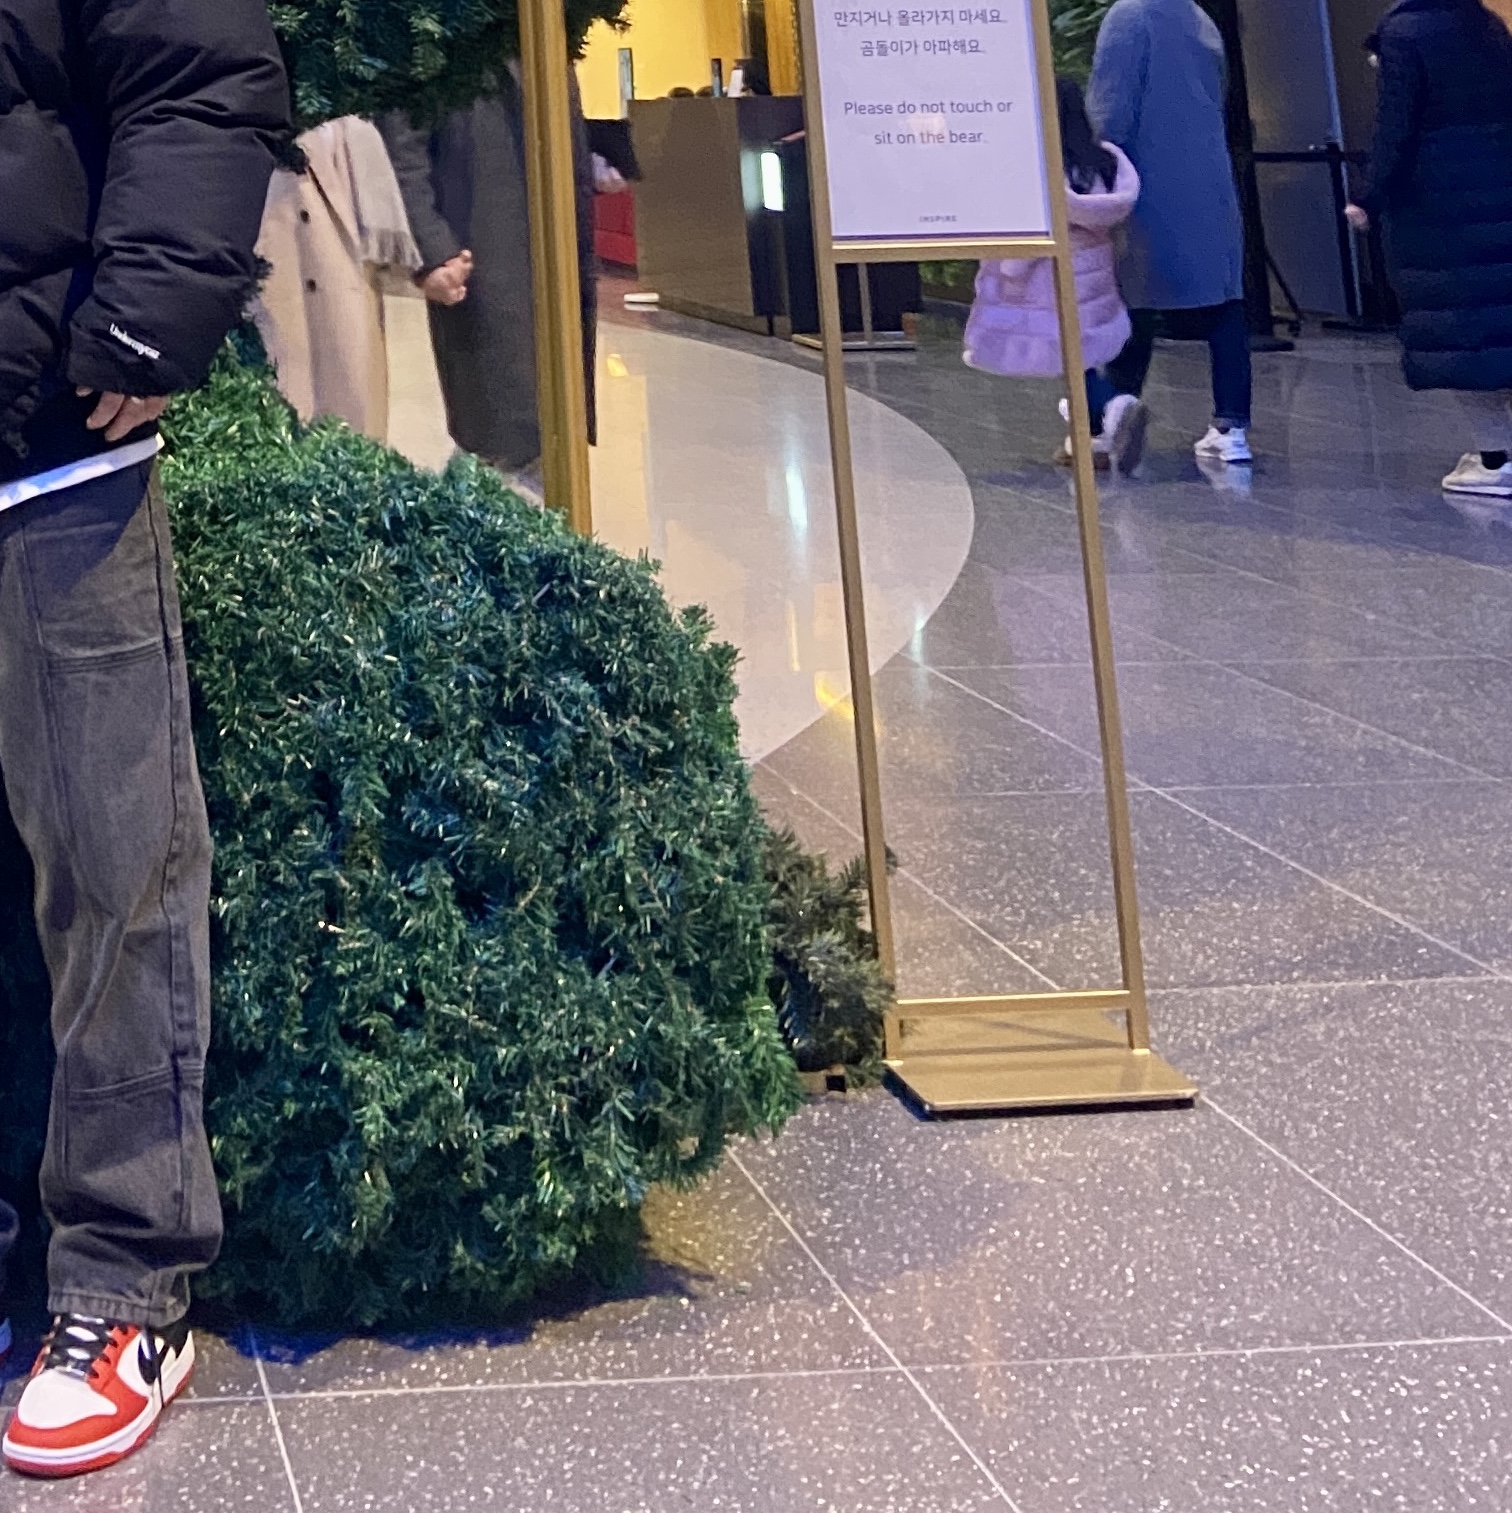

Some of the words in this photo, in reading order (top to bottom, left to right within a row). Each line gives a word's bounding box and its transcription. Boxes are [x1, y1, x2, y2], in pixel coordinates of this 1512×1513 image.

[833, 10, 892, 28] 만지거나
[897, 9, 954, 27] 올라가지
[860, 40, 918, 57] 곰돌이가
[844, 101, 894, 116] Please
[897, 101, 916, 115] do
[920, 101, 946, 114] not
[950, 100, 993, 114] touch
[997, 101, 1013, 113] or
[874, 131, 893, 145] sit
[896, 133, 916, 145] on
[919, 131, 945, 145] the
